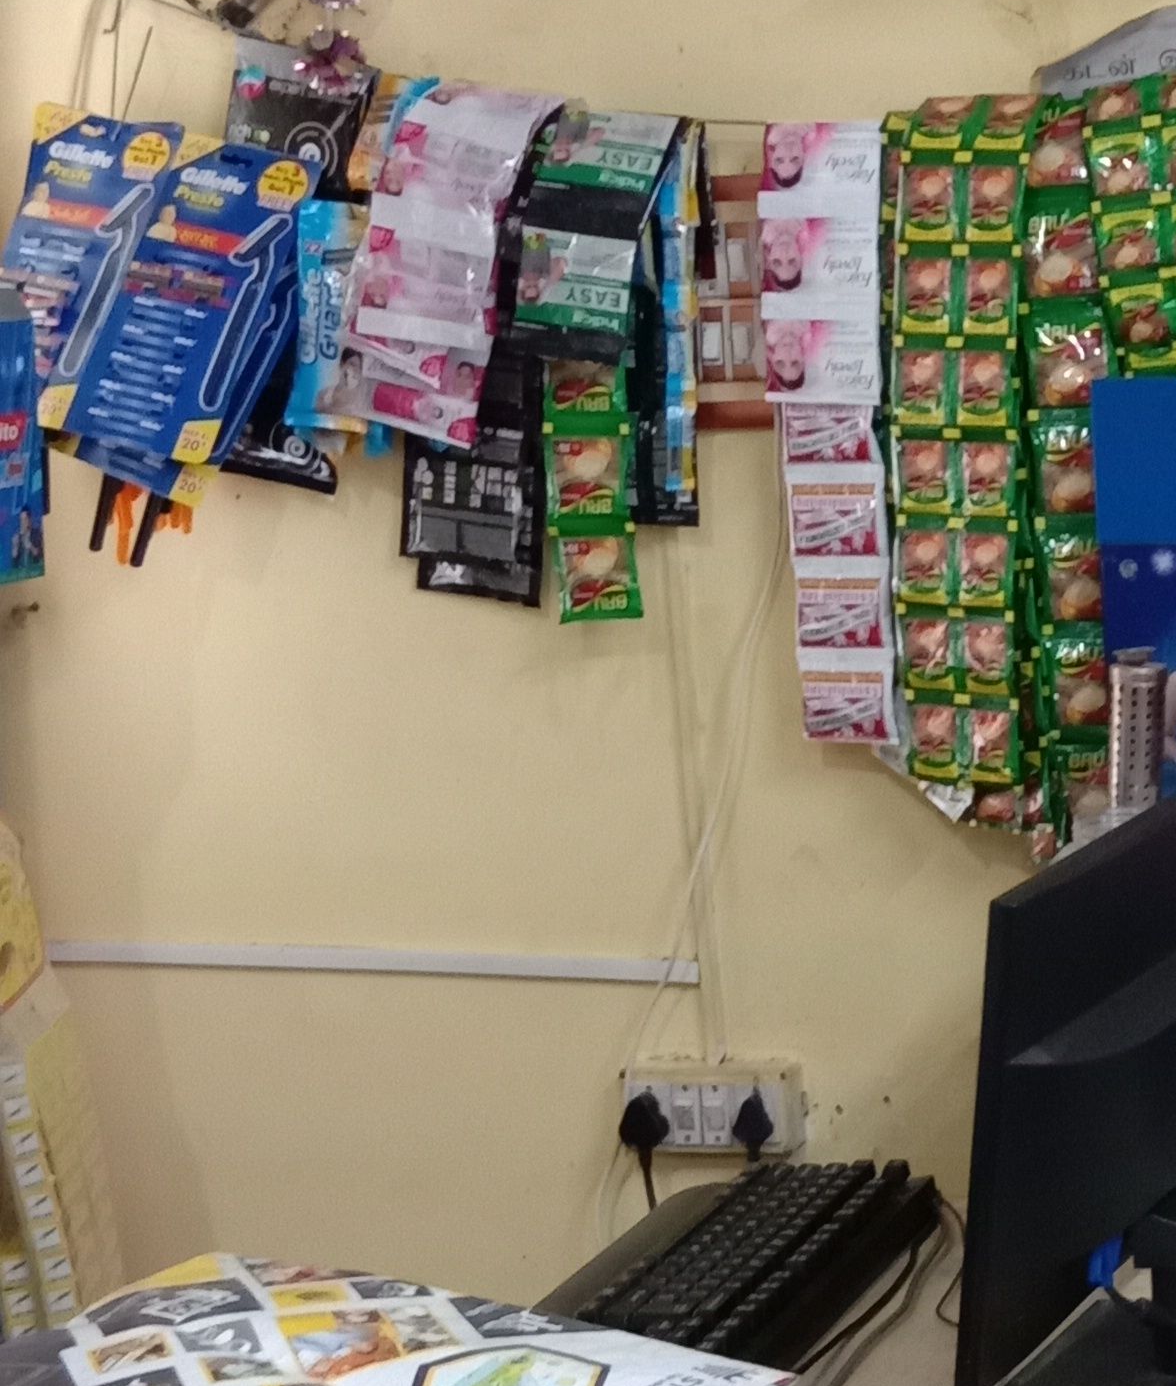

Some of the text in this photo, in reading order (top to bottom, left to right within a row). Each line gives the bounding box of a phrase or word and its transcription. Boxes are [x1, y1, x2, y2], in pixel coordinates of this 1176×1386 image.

[48, 140, 116, 171] Gillette
[595, 149, 655, 173] EASY
[180, 166, 251, 196] Gillette
[174, 184, 225, 210] Presto
[565, 288, 622, 308] EASY
[579, 496, 613, 515] BRU
[593, 593, 628, 612] BRU
